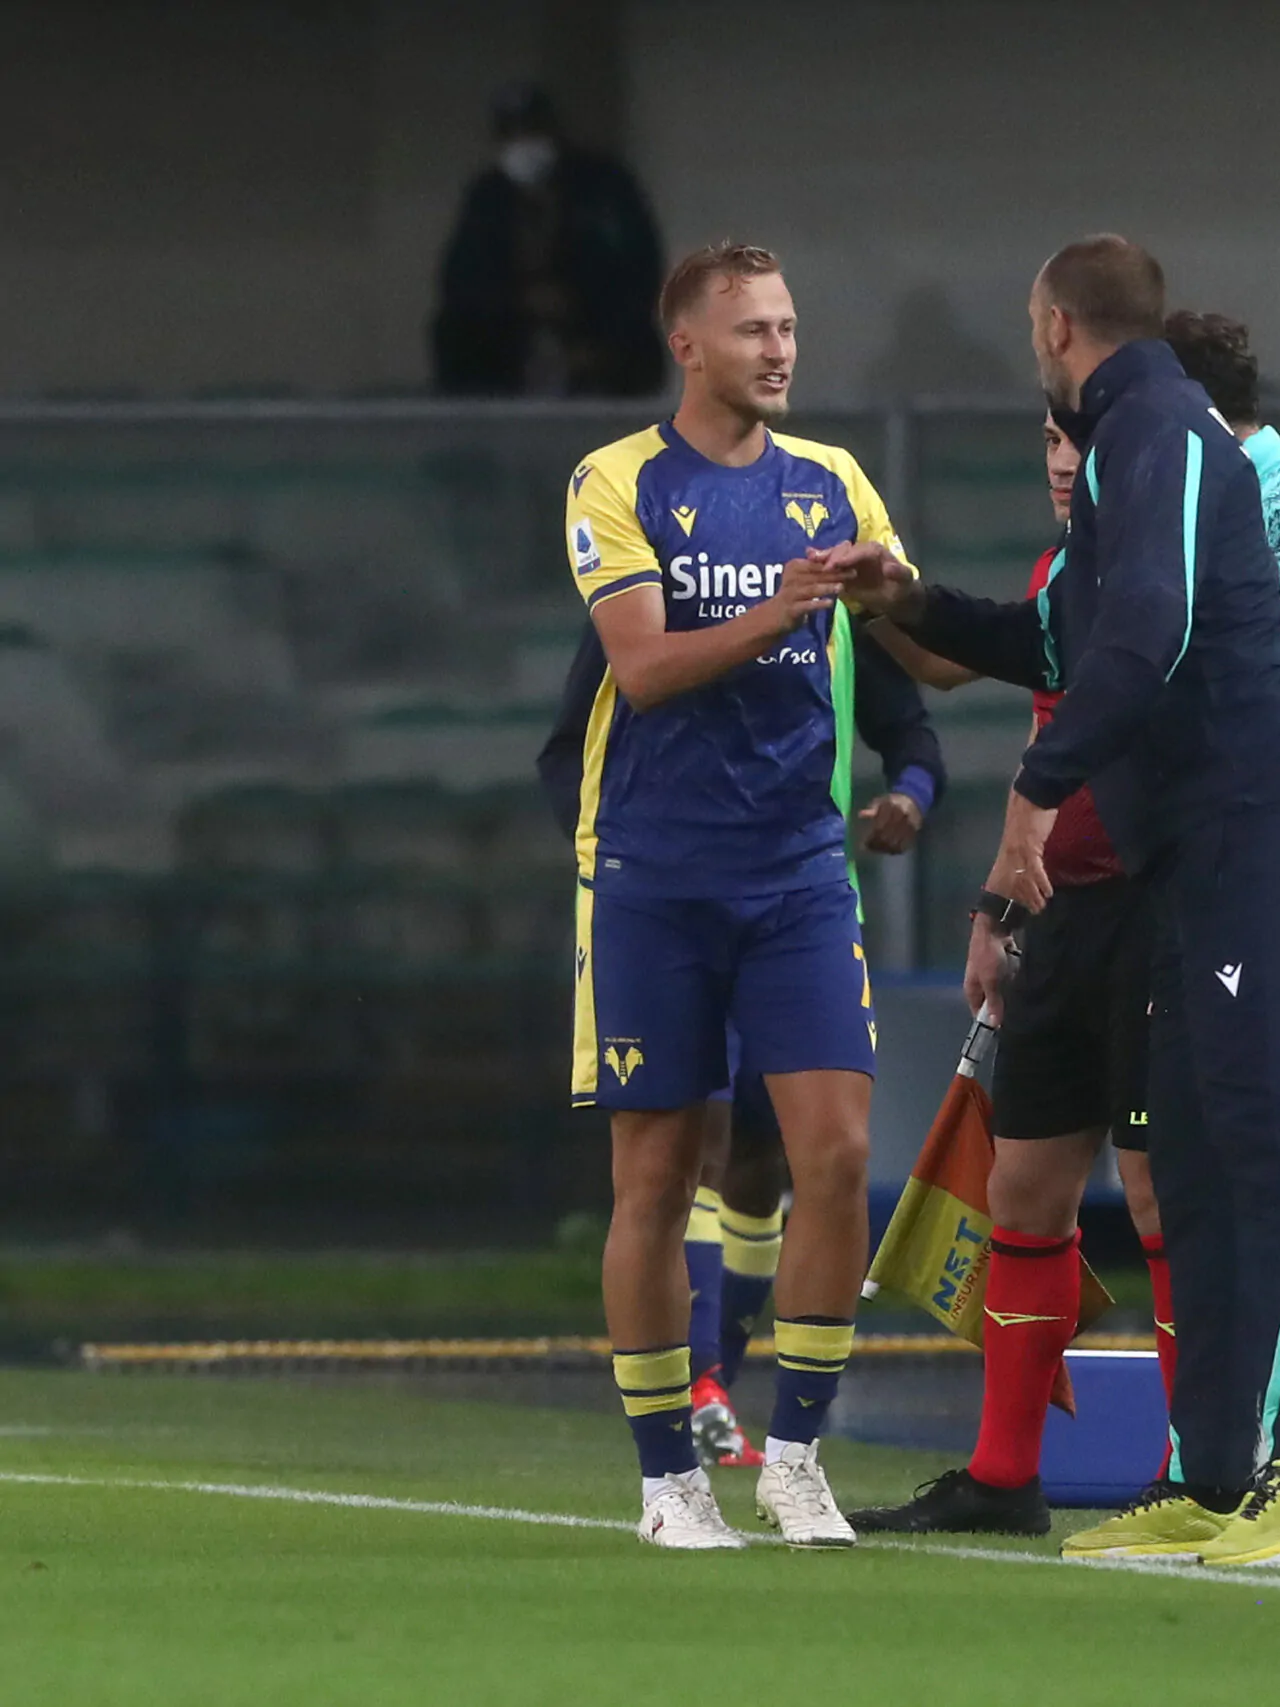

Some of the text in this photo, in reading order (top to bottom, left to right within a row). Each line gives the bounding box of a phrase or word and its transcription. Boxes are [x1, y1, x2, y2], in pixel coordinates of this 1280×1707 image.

[669, 552, 784, 600] Siner
[698, 602, 747, 618] Luce
[1130, 1111, 1149, 1125] LE
[932, 1215, 984, 1313] NET
[950, 1241, 993, 1321] INSURANC
